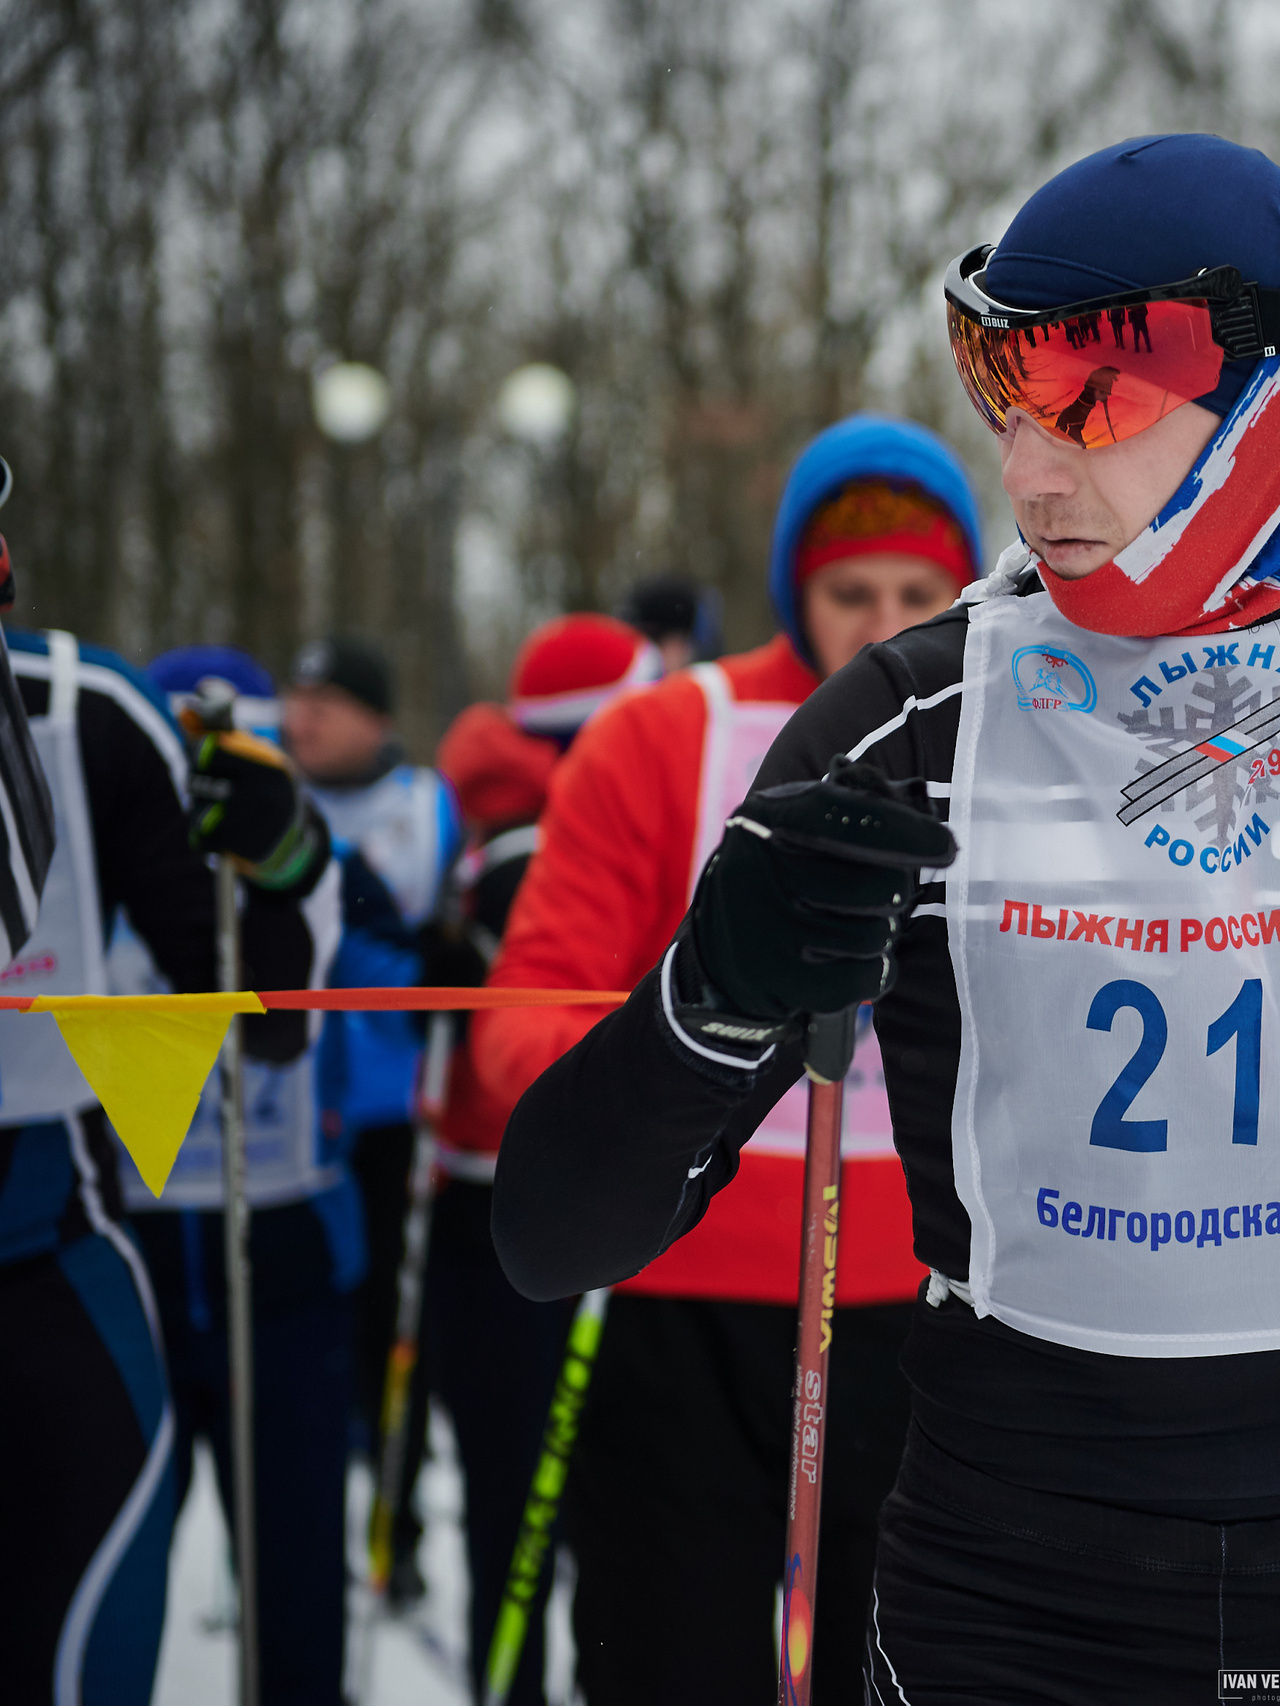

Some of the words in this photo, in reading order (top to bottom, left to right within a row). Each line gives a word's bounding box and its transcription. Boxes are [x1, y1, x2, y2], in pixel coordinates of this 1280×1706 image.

[991, 317, 1010, 329] BLIZ
[1143, 812, 1271, 875] РОССИИ
[1000, 899, 1169, 952] ЛЫЖНЯ
[802, 1370, 823, 1483] star
